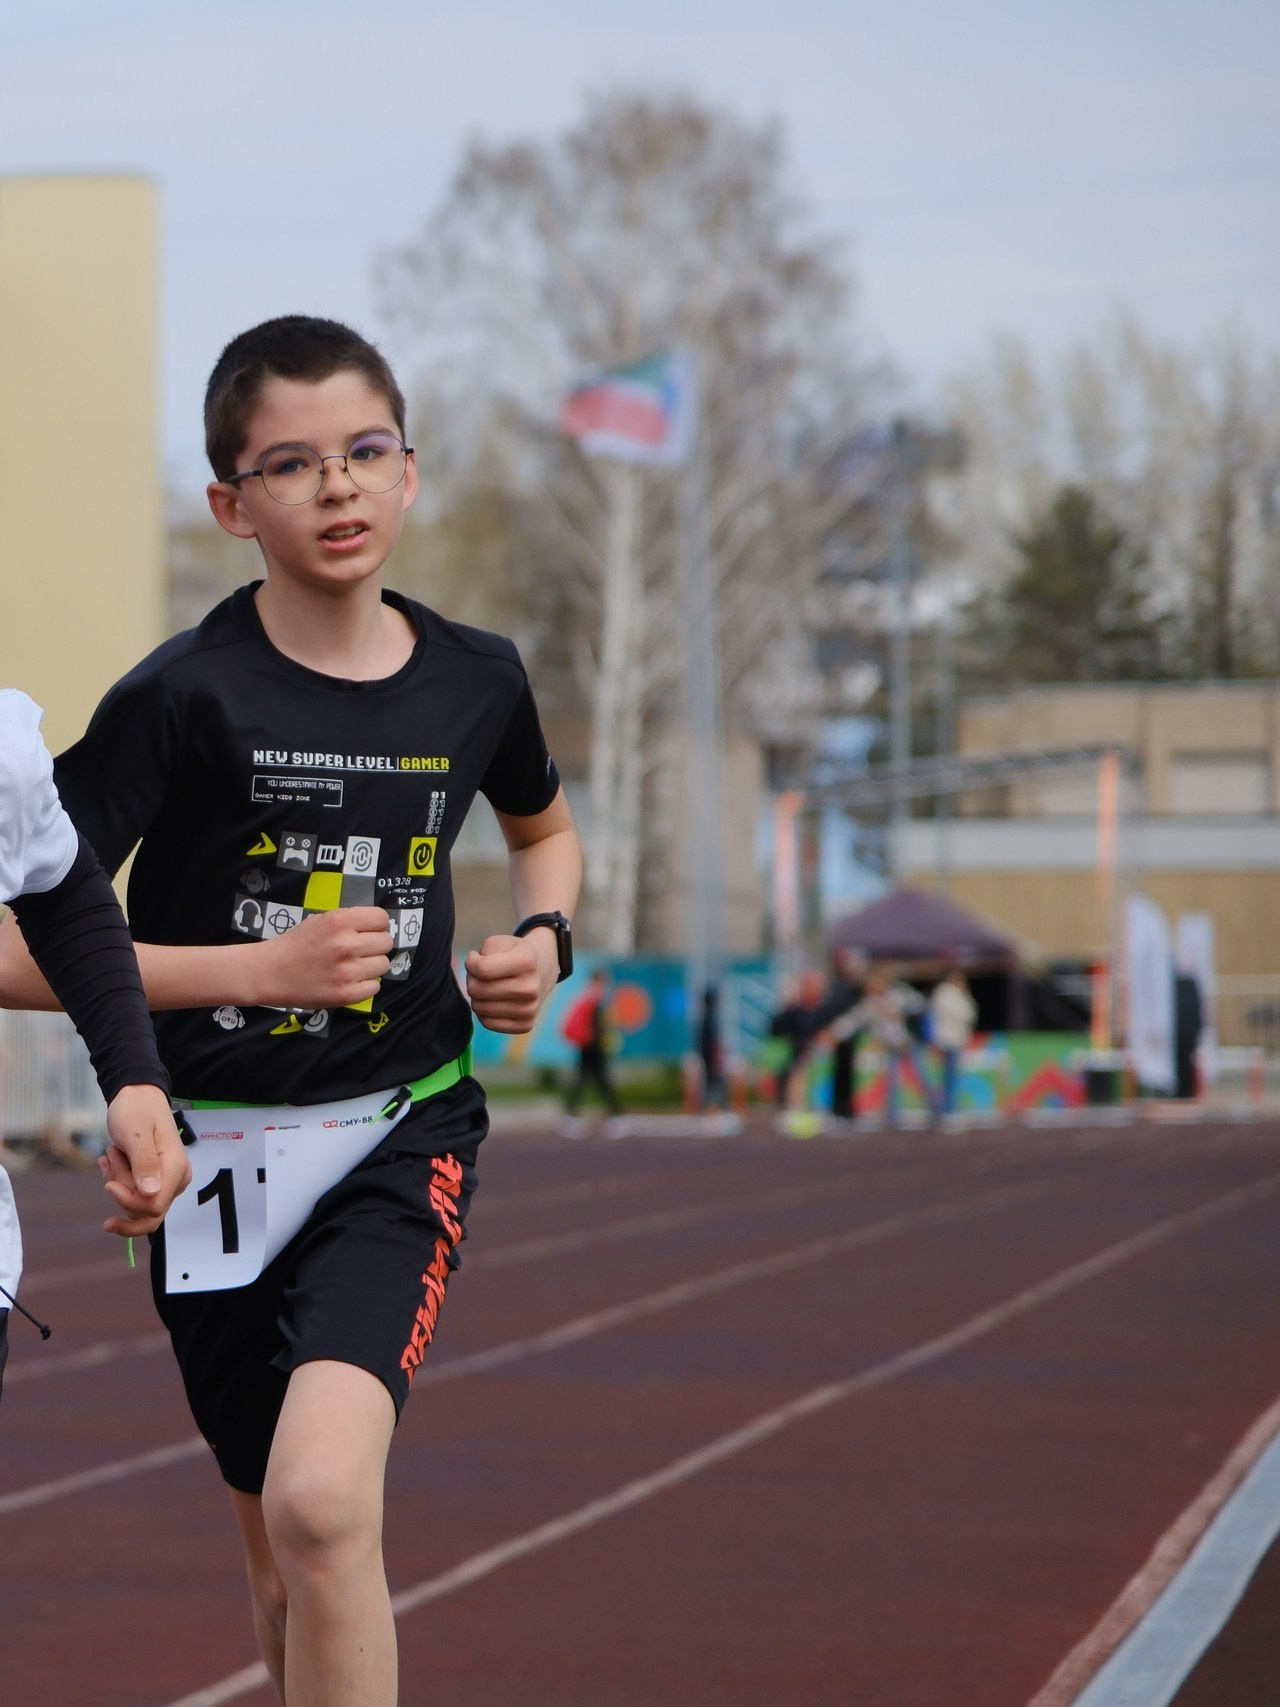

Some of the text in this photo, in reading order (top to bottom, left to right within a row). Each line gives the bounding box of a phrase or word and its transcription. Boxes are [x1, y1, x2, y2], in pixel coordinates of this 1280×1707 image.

[253, 750, 450, 770] NEW SUPER LEVEL GAMER
[339, 1116, 373, 1128] СМУ-88
[200, 1132, 244, 1140] МИНСПОРТ
